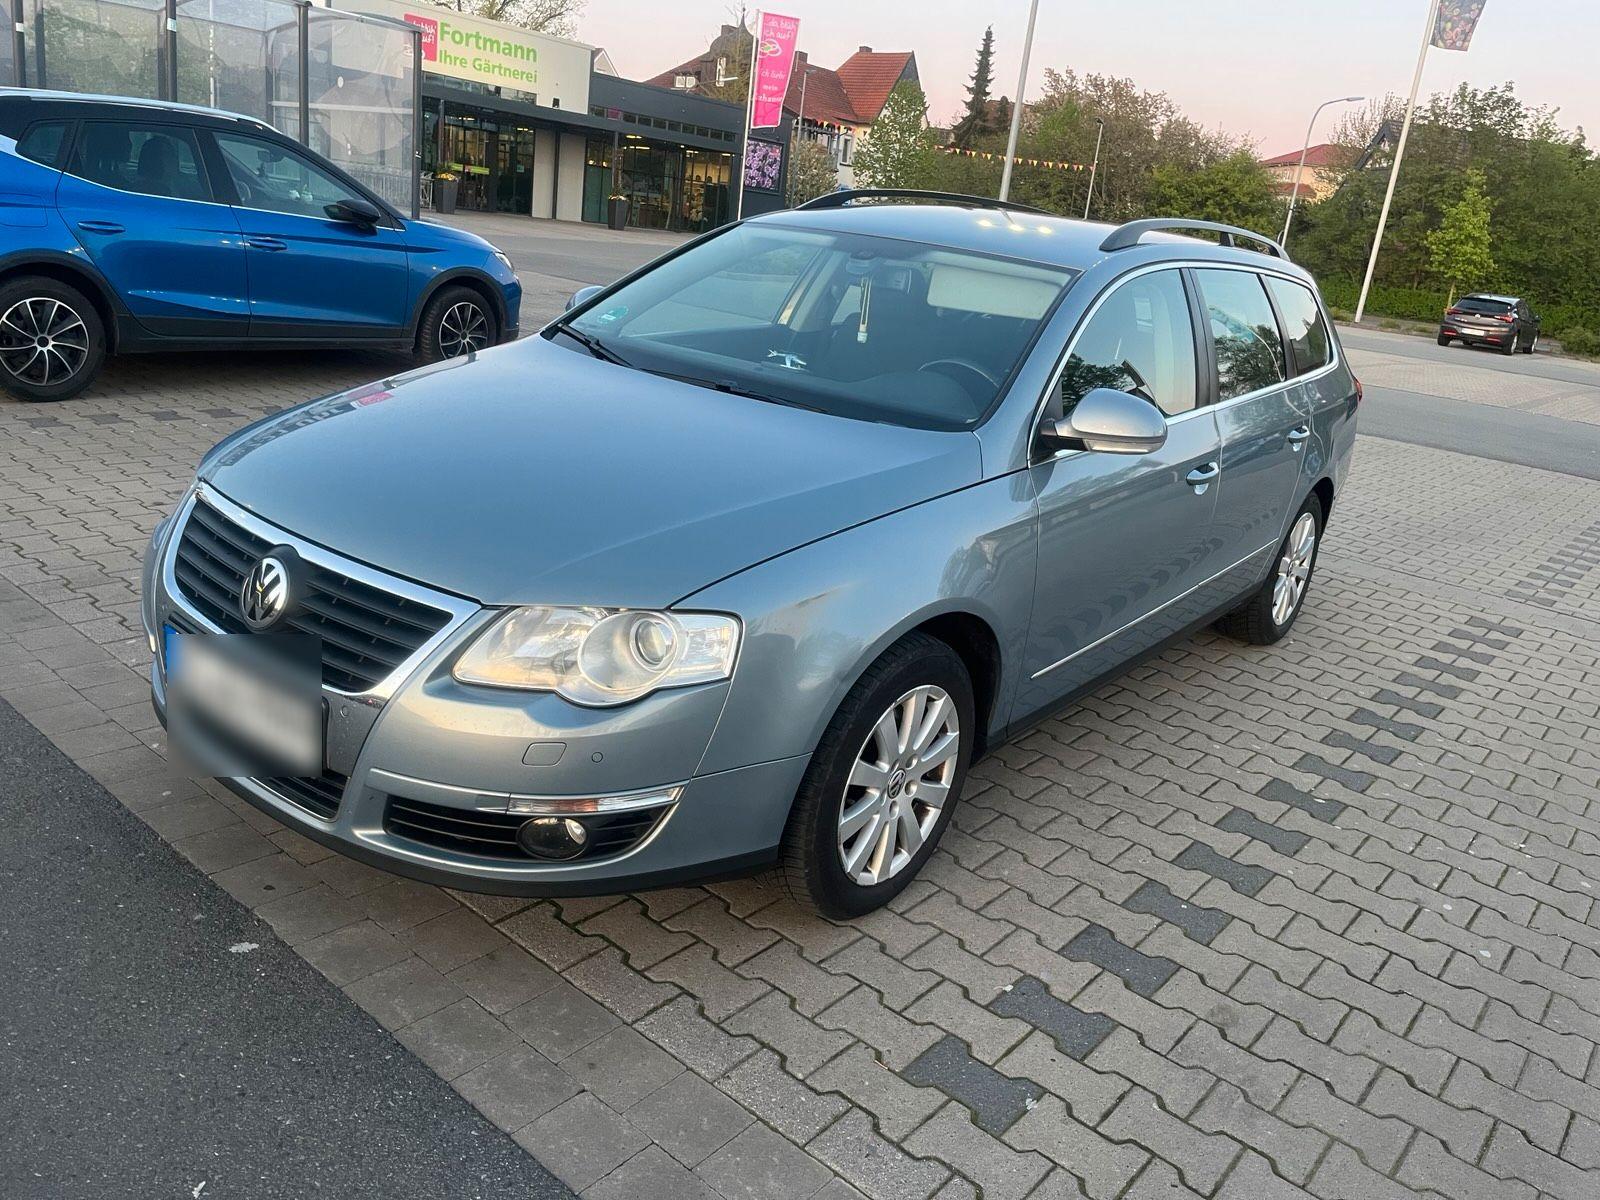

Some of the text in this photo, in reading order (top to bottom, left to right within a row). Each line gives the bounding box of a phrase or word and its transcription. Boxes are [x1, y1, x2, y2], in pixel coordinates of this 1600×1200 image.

[440, 22, 537, 62] Fortmann
[440, 50, 537, 83] Ihre Gärtnerei
